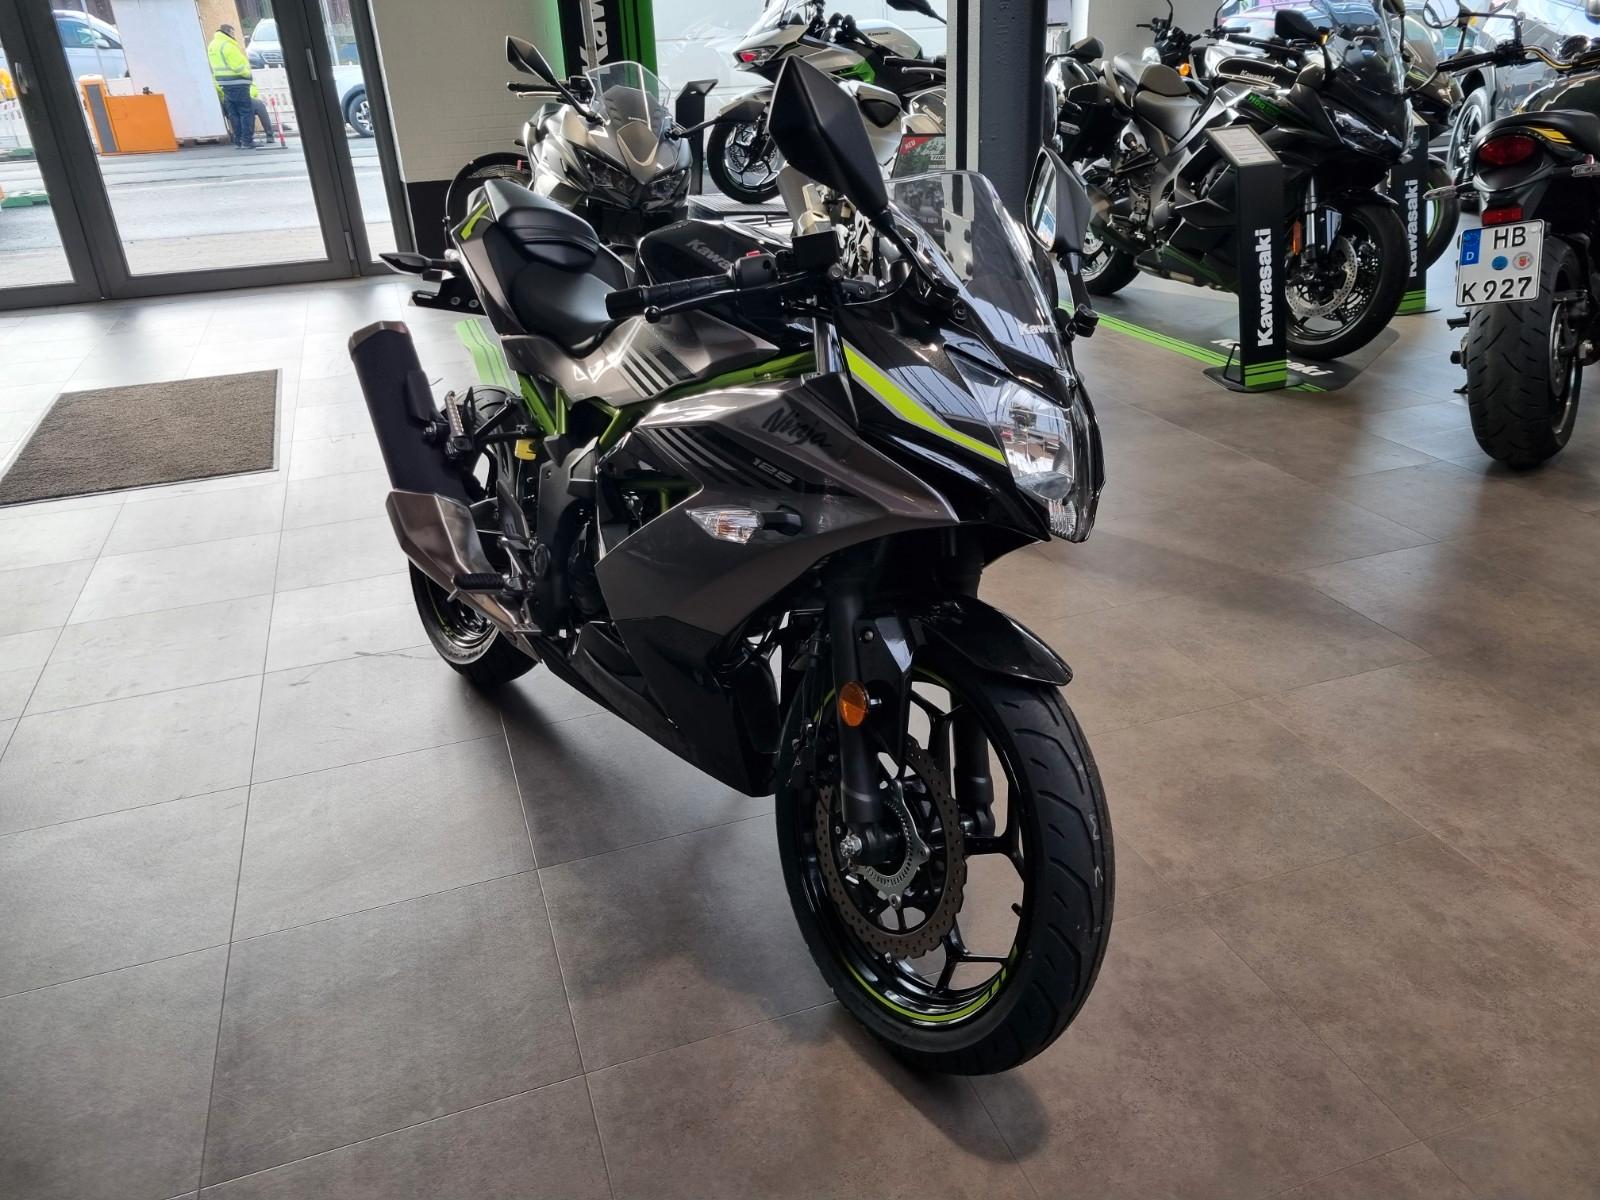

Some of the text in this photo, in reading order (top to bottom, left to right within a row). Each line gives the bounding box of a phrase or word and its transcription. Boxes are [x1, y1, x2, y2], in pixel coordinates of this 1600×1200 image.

[1404, 179, 1419, 277] Kawasaki
[1493, 226, 1527, 250] HB
[1255, 228, 1274, 347] Kawasaki
[761, 407, 833, 447] Ninja
[752, 457, 796, 484] 125
